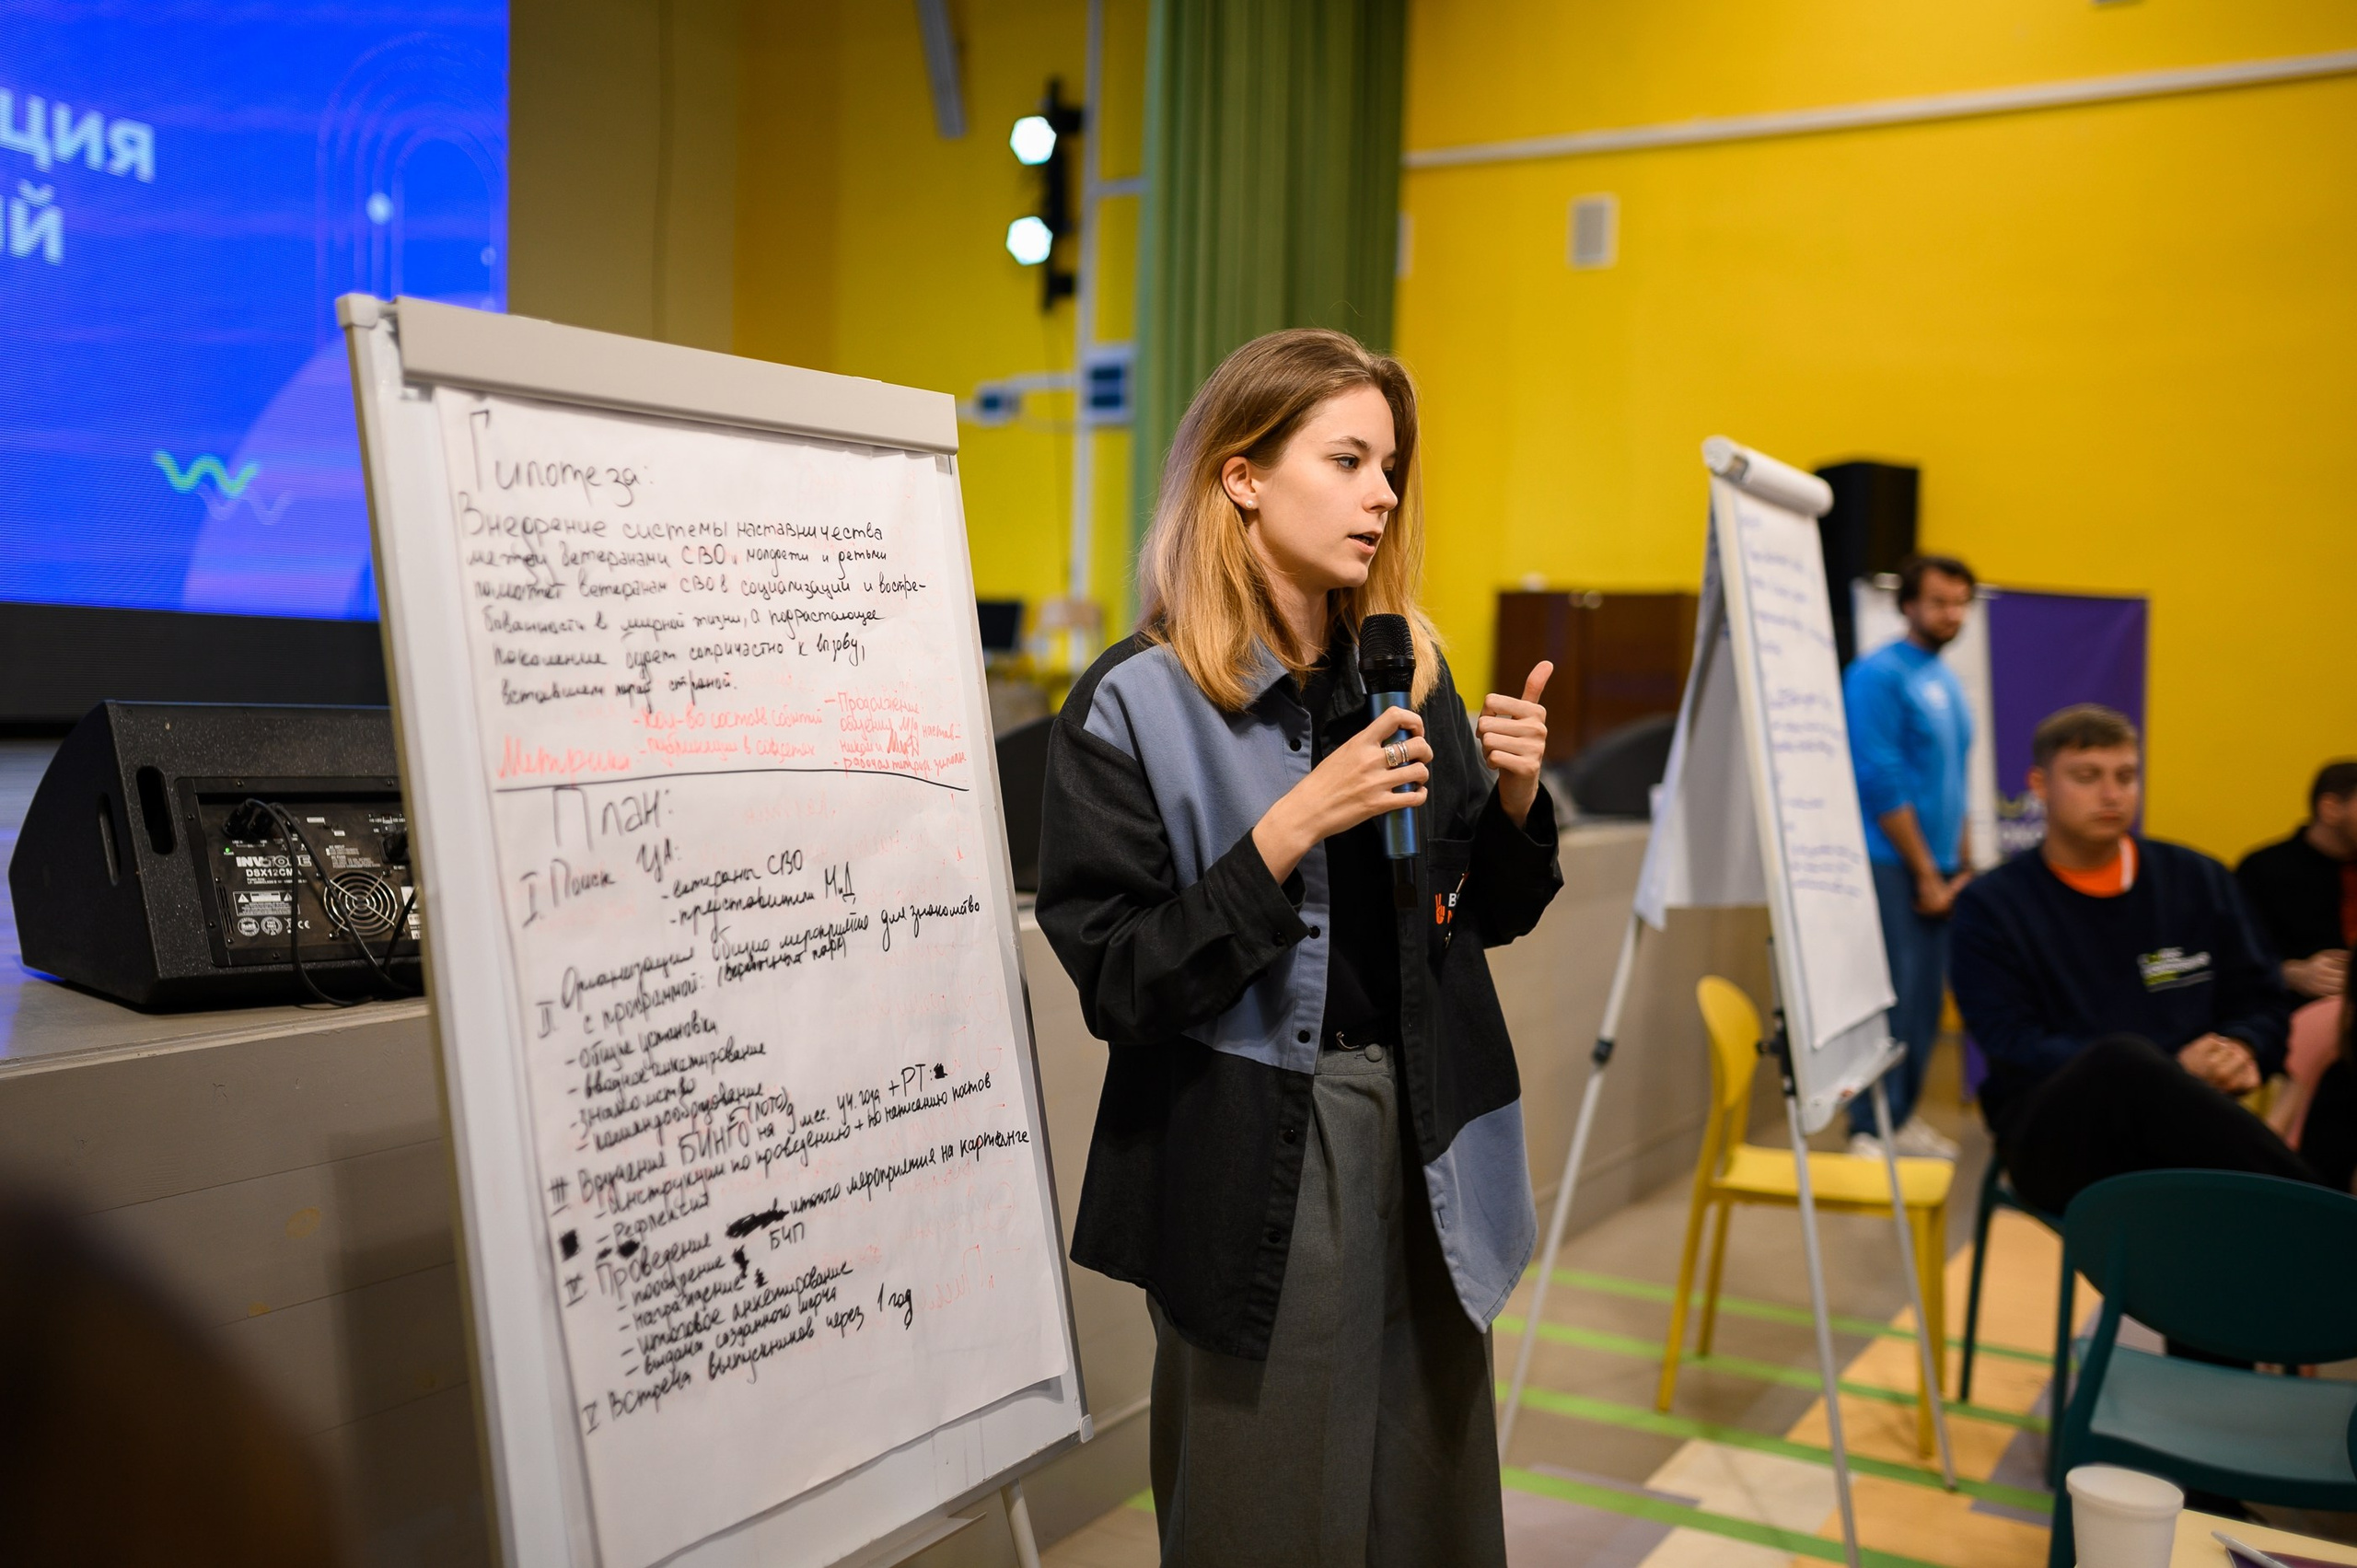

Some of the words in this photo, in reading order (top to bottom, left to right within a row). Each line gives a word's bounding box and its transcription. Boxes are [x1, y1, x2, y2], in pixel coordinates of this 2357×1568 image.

[469, 409, 654, 507] Гипотеза:
[622, 521, 727, 540] системы
[737, 521, 883, 541] наставничества
[679, 576, 714, 594] СВО
[720, 574, 728, 593] в
[740, 580, 851, 599] социализации
[864, 581, 874, 592] и
[798, 641, 808, 656] к
[552, 786, 674, 851] План:
[767, 849, 803, 876] СВО
